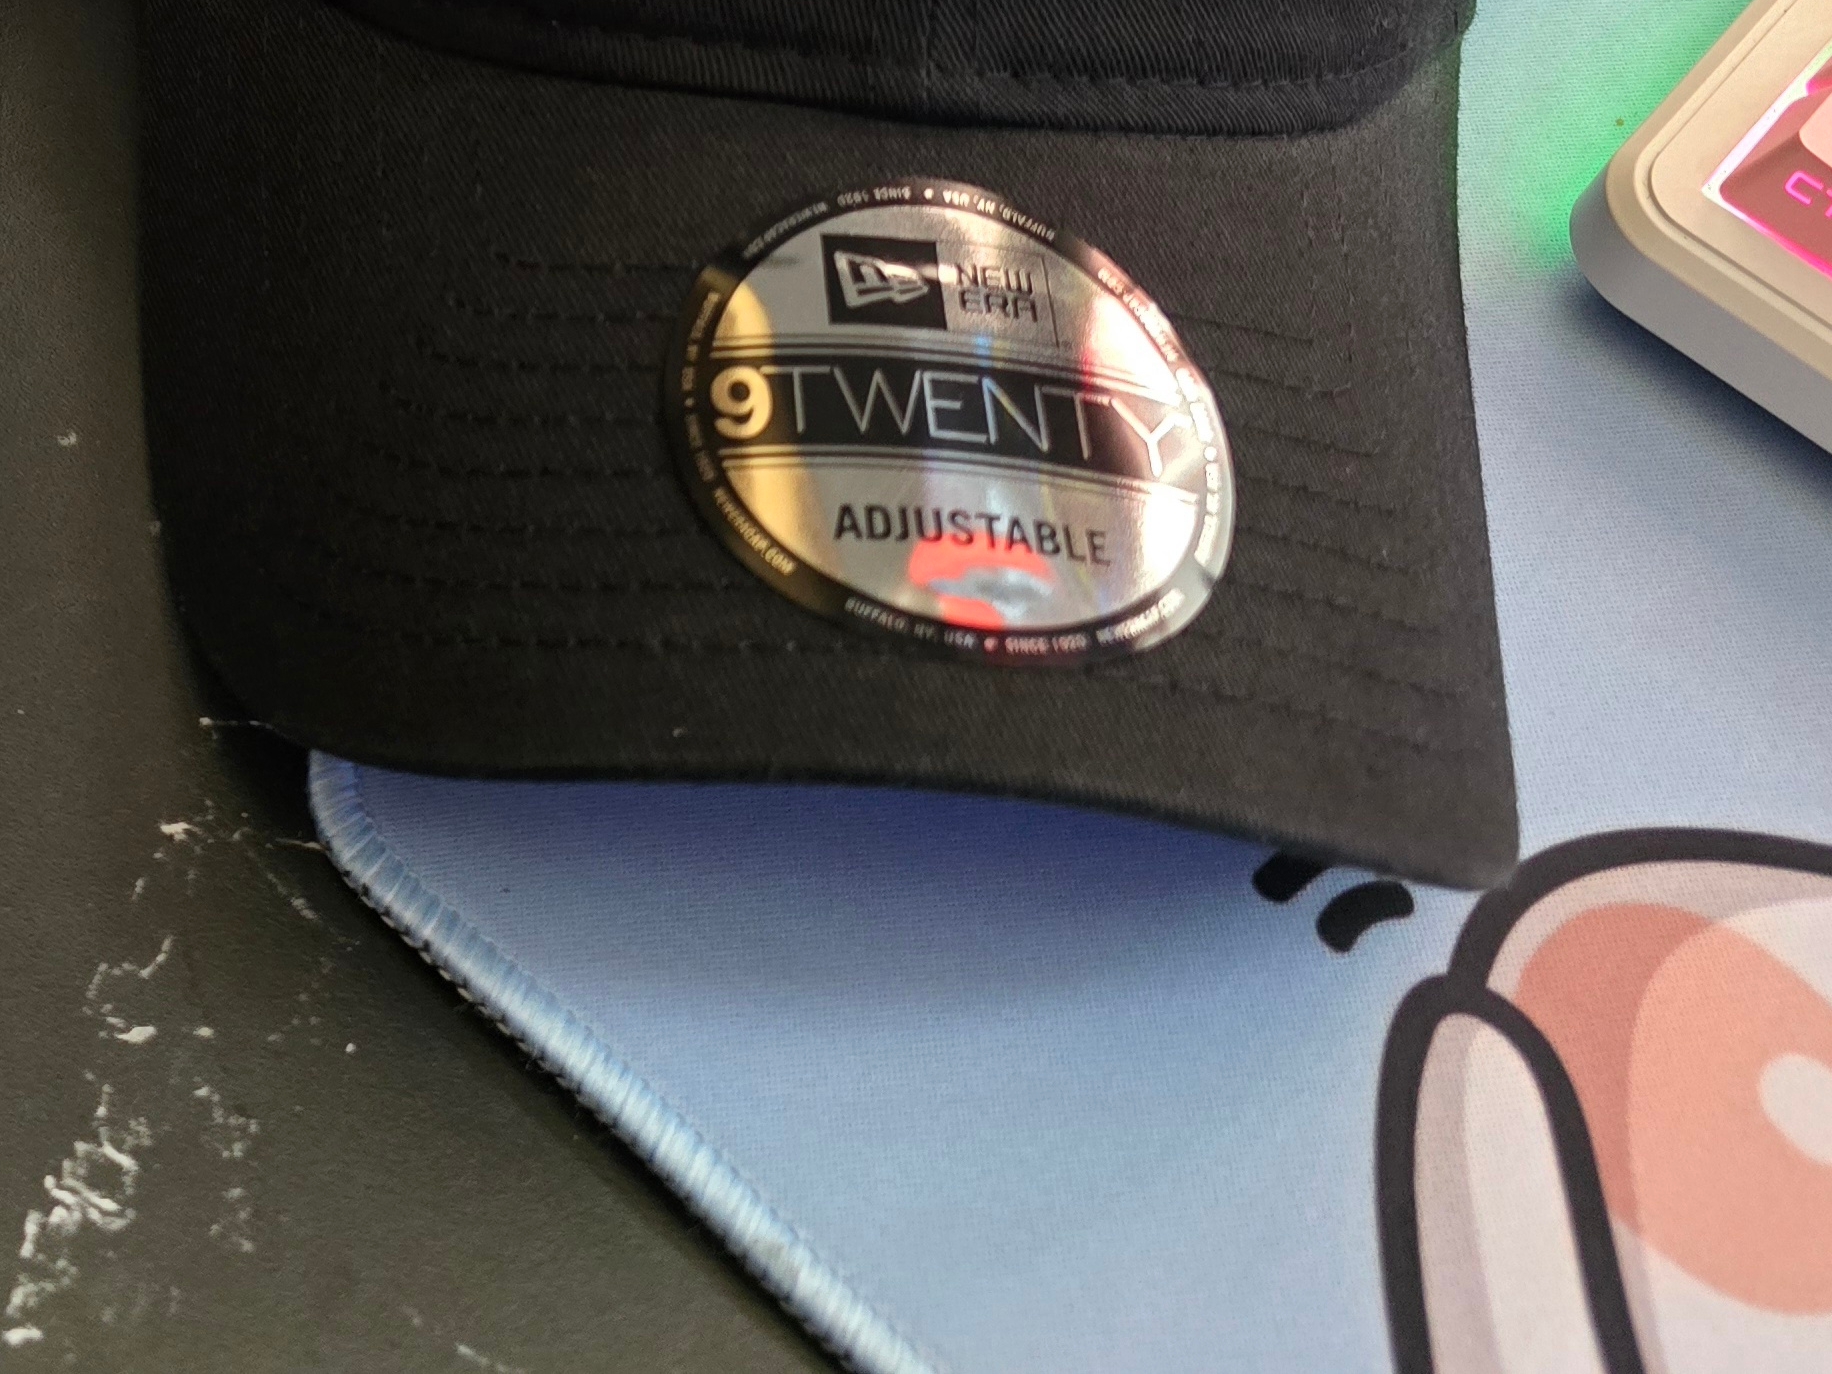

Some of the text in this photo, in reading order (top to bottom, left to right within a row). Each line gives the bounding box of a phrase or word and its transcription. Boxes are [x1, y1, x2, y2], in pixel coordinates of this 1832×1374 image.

[953, 261, 1034, 296] NEW
[958, 287, 1039, 324] ERA
[709, 363, 1193, 477] 9TWENTY
[832, 503, 1112, 567] ADJUSTABLE
